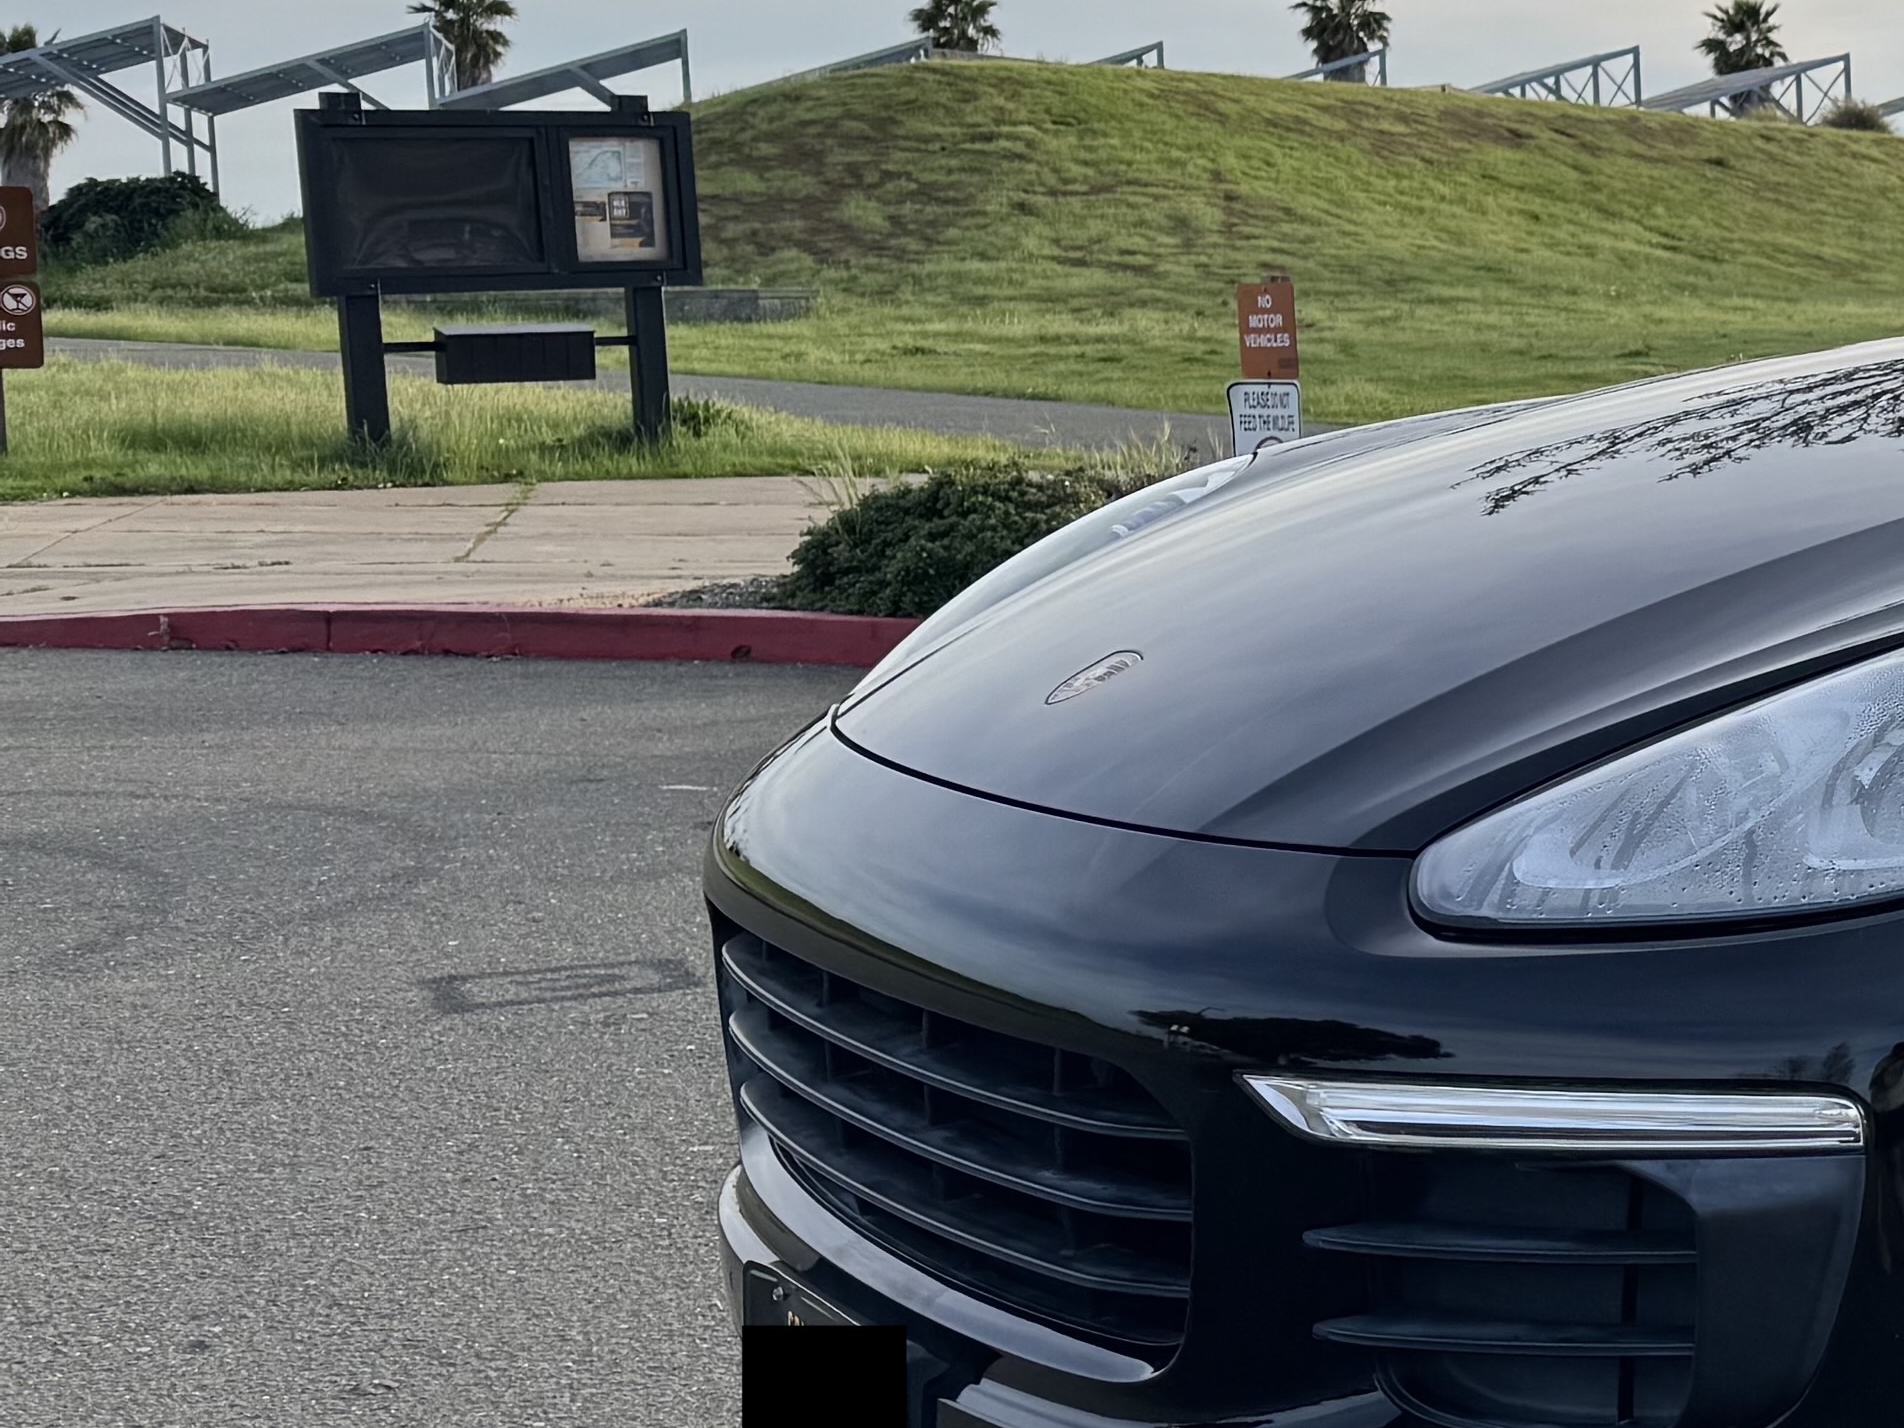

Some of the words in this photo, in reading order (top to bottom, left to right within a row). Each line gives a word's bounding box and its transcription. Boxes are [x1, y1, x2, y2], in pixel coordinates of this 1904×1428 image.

[0, 246, 28, 259] GS
[1257, 294, 1272, 308] NO
[1248, 313, 1283, 328] MOTOR
[1243, 333, 1290, 347] VEHICLES
[1243, 391, 1270, 409] PLEASE
[1239, 414, 1257, 432] FEED
[1258, 414, 1271, 431] THE
